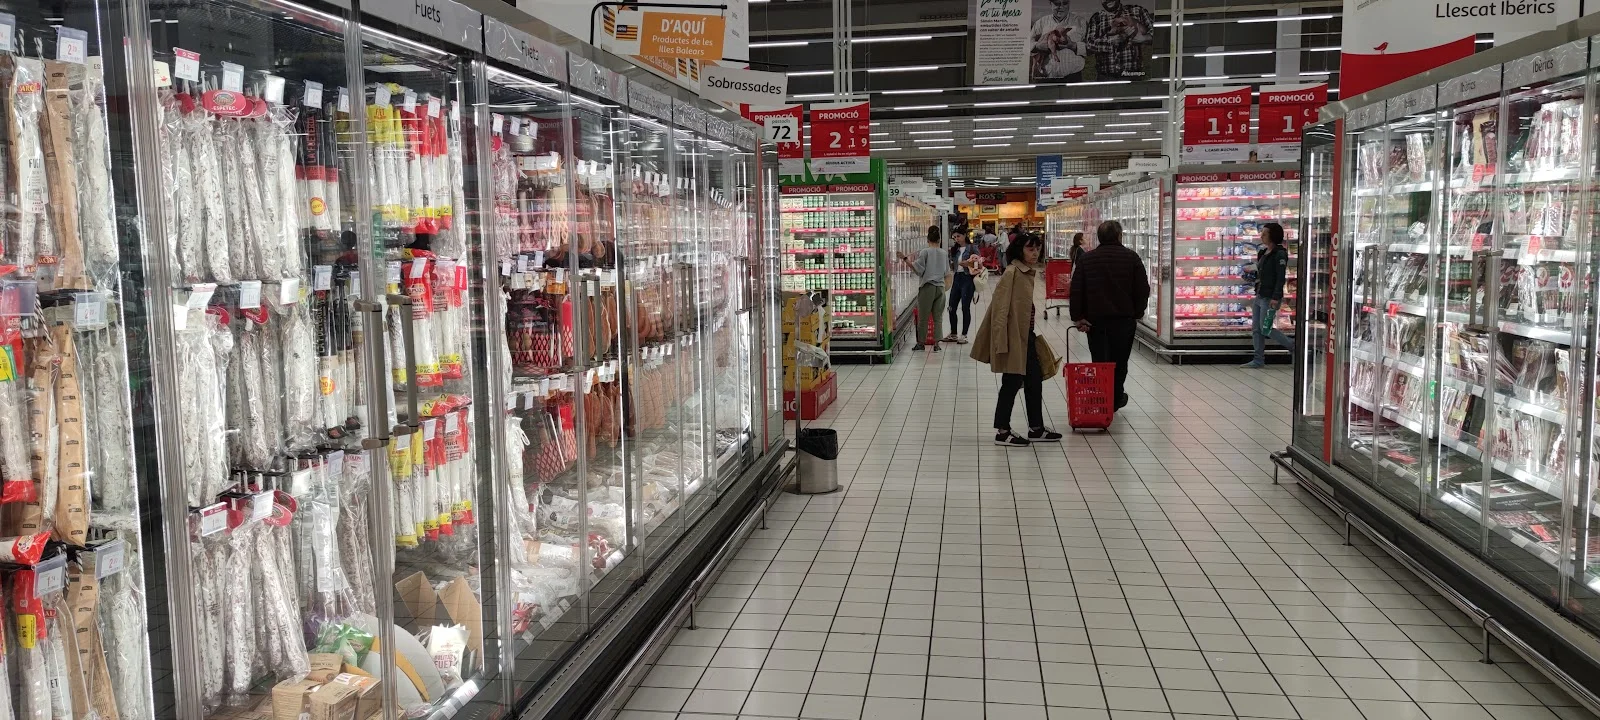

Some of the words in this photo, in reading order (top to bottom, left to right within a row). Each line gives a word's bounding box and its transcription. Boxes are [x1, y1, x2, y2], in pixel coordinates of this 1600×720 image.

[1436, 3, 1497, 18] Llescat
[1501, 0, 1555, 15] Ibérics
[661, 18, 707, 36] D'AQUÍ
[652, 35, 690, 45] Productes
[691, 37, 701, 46] de
[702, 38, 713, 46] les
[659, 45, 674, 53] Illes
[675, 46, 705, 56] Balears
[707, 75, 782, 95] Sobrassades
[1197, 95, 1242, 105] PROMOCIÓ
[1269, 92, 1315, 102] PROMOCIÓ
[819, 110, 859, 119] PROMOCIÓ
[1207, 117, 1220, 135] 1
[1240, 123, 1247, 134] 8
[1282, 115, 1295, 133] 1
[772, 126, 790, 139] 72
[829, 131, 842, 149] 2
[861, 137, 868, 147] 9
[1181, 174, 1219, 182] PROMOCIÓ
[1239, 172, 1277, 180] PROMOCIÓ
[788, 185, 821, 193] PROMOCIÓ
[835, 183, 868, 192] PROMOCIÓ
[889, 188, 900, 196] 39
[1329, 232, 1339, 354] PROMOCIÓ
